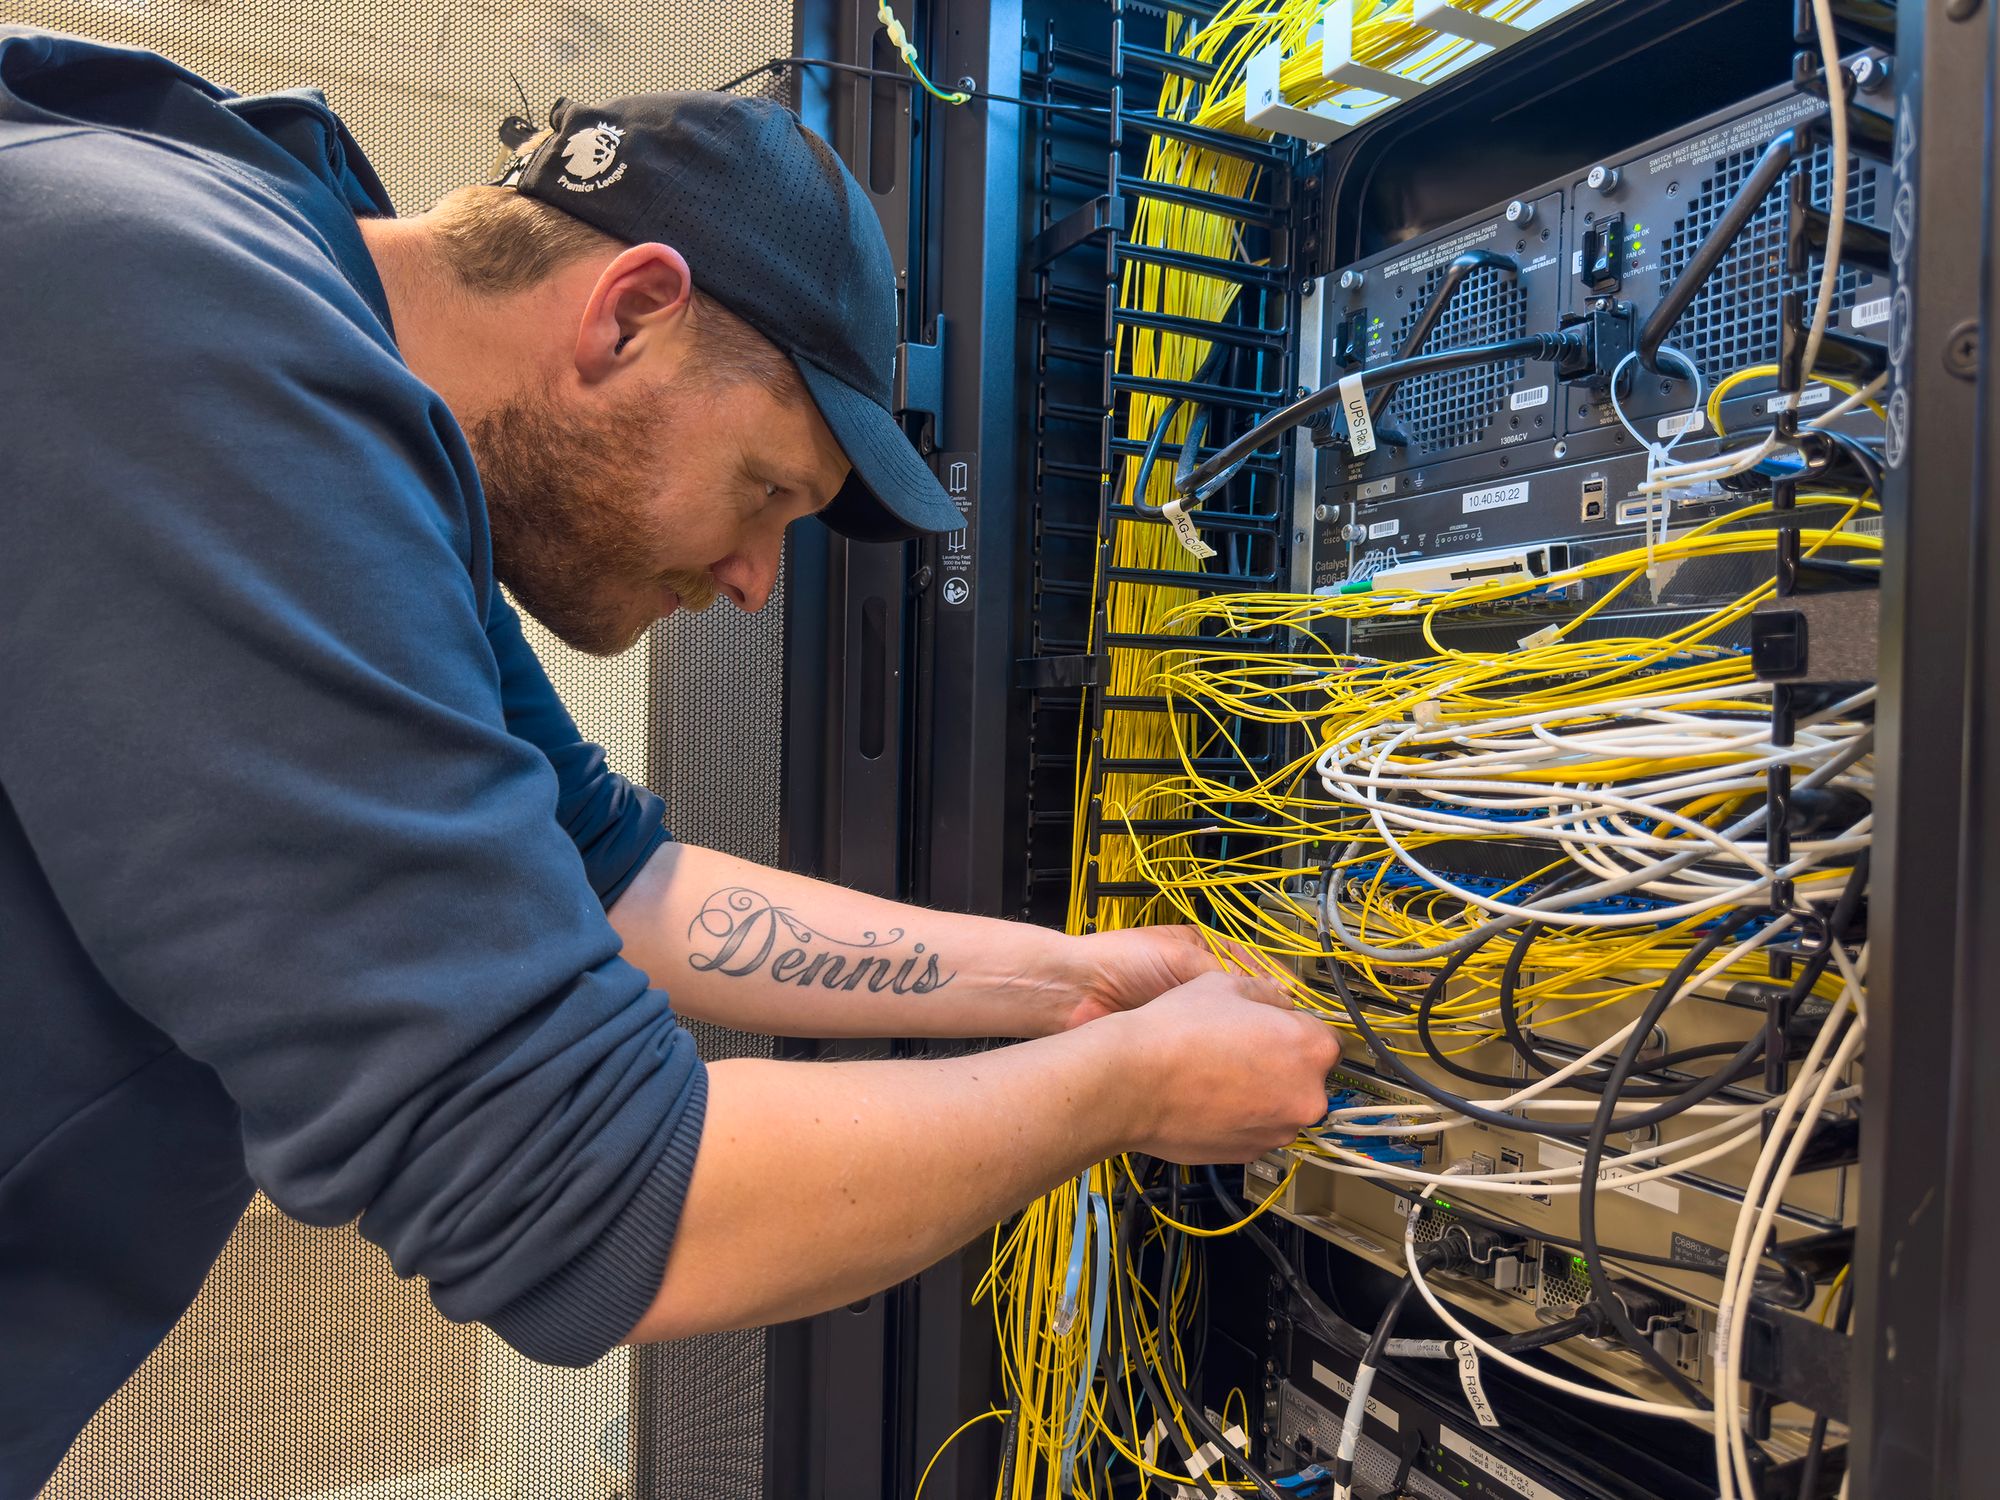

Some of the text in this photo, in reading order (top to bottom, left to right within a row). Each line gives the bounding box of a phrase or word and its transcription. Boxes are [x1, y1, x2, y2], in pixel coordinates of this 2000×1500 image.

[1649, 153, 1671, 167] SWITCH
[1672, 145, 1689, 157] MUST
[1690, 142, 1699, 151] BE
[1700, 139, 1707, 147] IN
[1707, 134, 1719, 144] OFF
[1732, 117, 1763, 134] POSITION
[1764, 113, 1773, 121] TO
[1774, 102, 1801, 117] INSTALL
[1675, 146, 1710, 164] FASTENERS
[1710, 138, 1728, 150] MUST
[1730, 134, 1738, 143] BE
[1740, 126, 1760, 141] FULLY
[1760, 114, 1792, 131] ENGAGED
[1793, 105, 1814, 118] PRIOR
[1692, 129, 1775, 166] OPERATING POWER SUPPLY
[557, 162, 628, 193] Premier League
[1625, 252, 1637, 260] FAN
[1622, 267, 1644, 279] OUTPUT
[1349, 399, 1365, 428] UPS
[1356, 428, 1369, 447] Rac
[1500, 432, 1528, 446] 1300ACV
[1469, 487, 1520, 507] 10.40.50.22
[1315, 559, 1348, 572] Catalyst
[688, 887, 957, 994] Dennis
[1398, 1199, 1404, 1211] A
[1674, 1236, 1711, 1256] C6880-X
[1459, 1341, 1492, 1423] ATS Rack 2
[1469, 1445, 1484, 1458] Input
